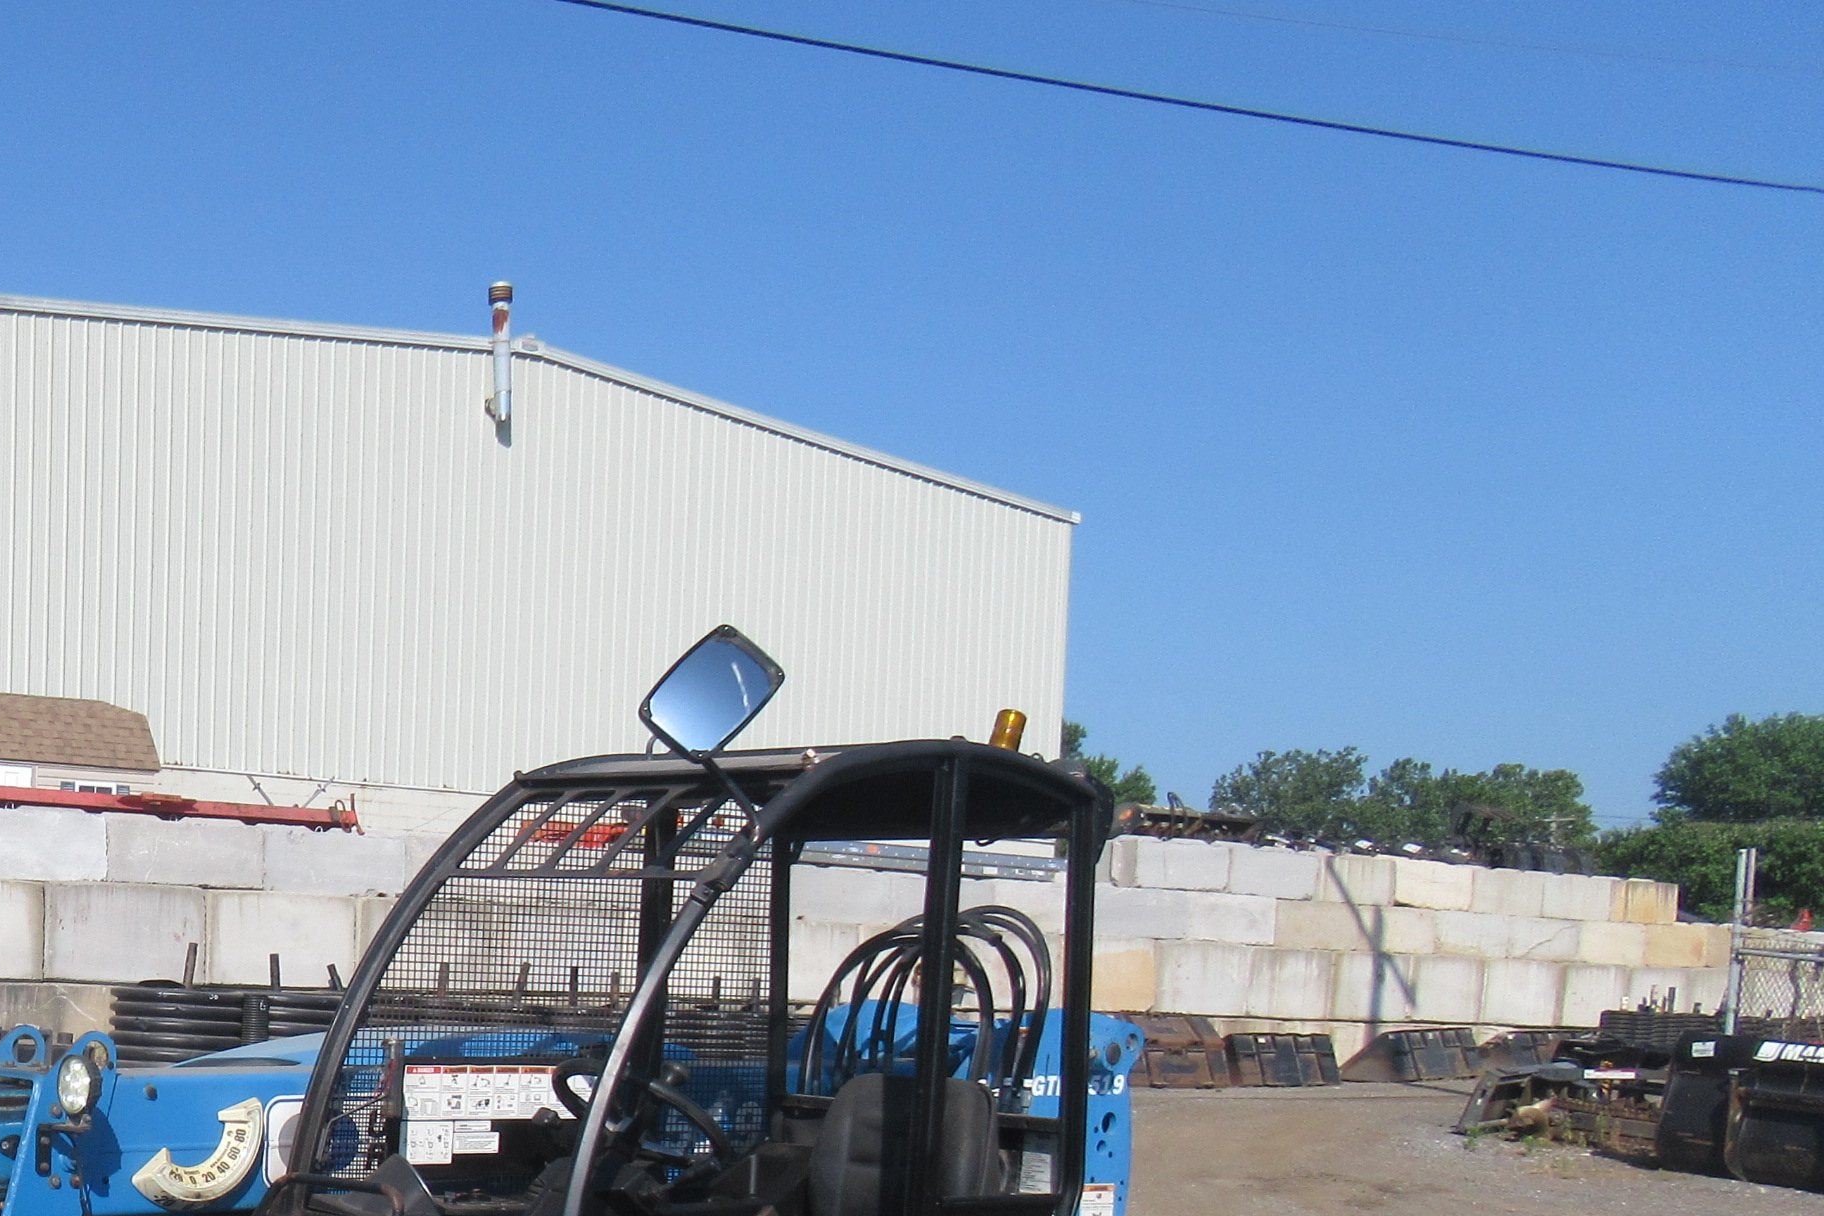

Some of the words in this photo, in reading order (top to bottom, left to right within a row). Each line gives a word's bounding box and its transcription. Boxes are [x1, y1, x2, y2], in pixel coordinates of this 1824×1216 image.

[189, 1175, 197, 1185] 0
[202, 1171, 216, 1183] 20
[216, 1161, 231, 1174] 40
[227, 1146, 241, 1161] 60
[234, 1128, 247, 1143] 80
